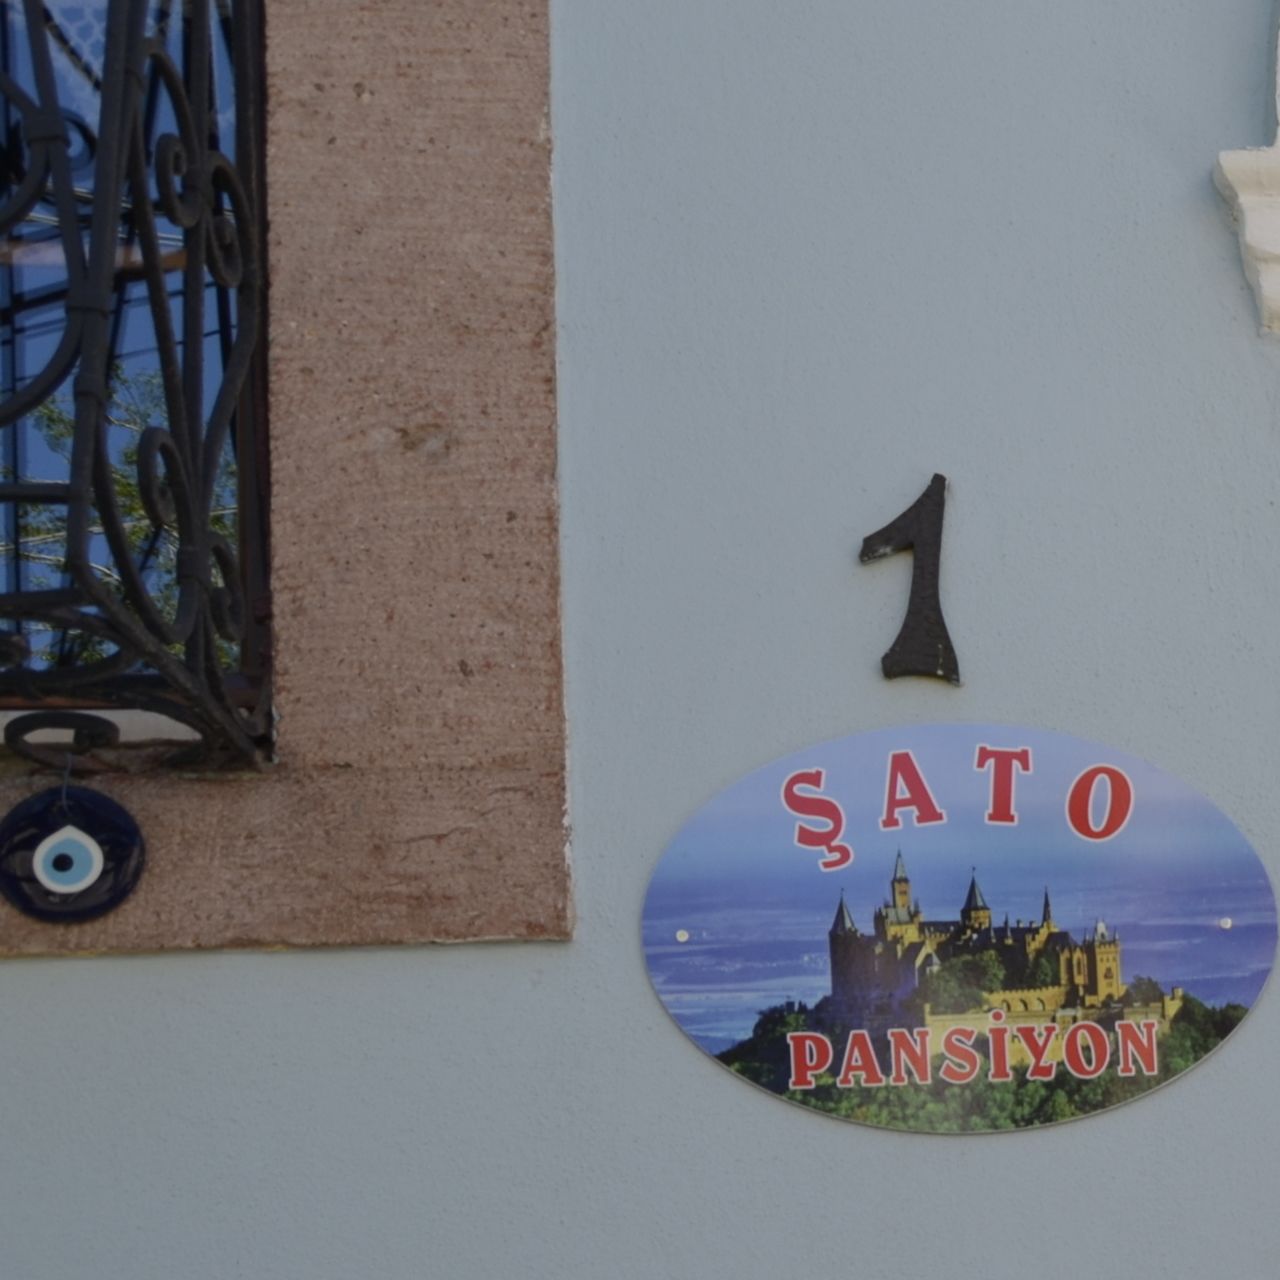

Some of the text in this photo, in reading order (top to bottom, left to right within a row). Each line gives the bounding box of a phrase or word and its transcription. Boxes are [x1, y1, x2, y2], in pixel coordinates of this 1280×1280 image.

[859, 472, 962, 687] 1
[781, 744, 1135, 872] ŞATO
[787, 1010, 1159, 1090] PANSİYON
